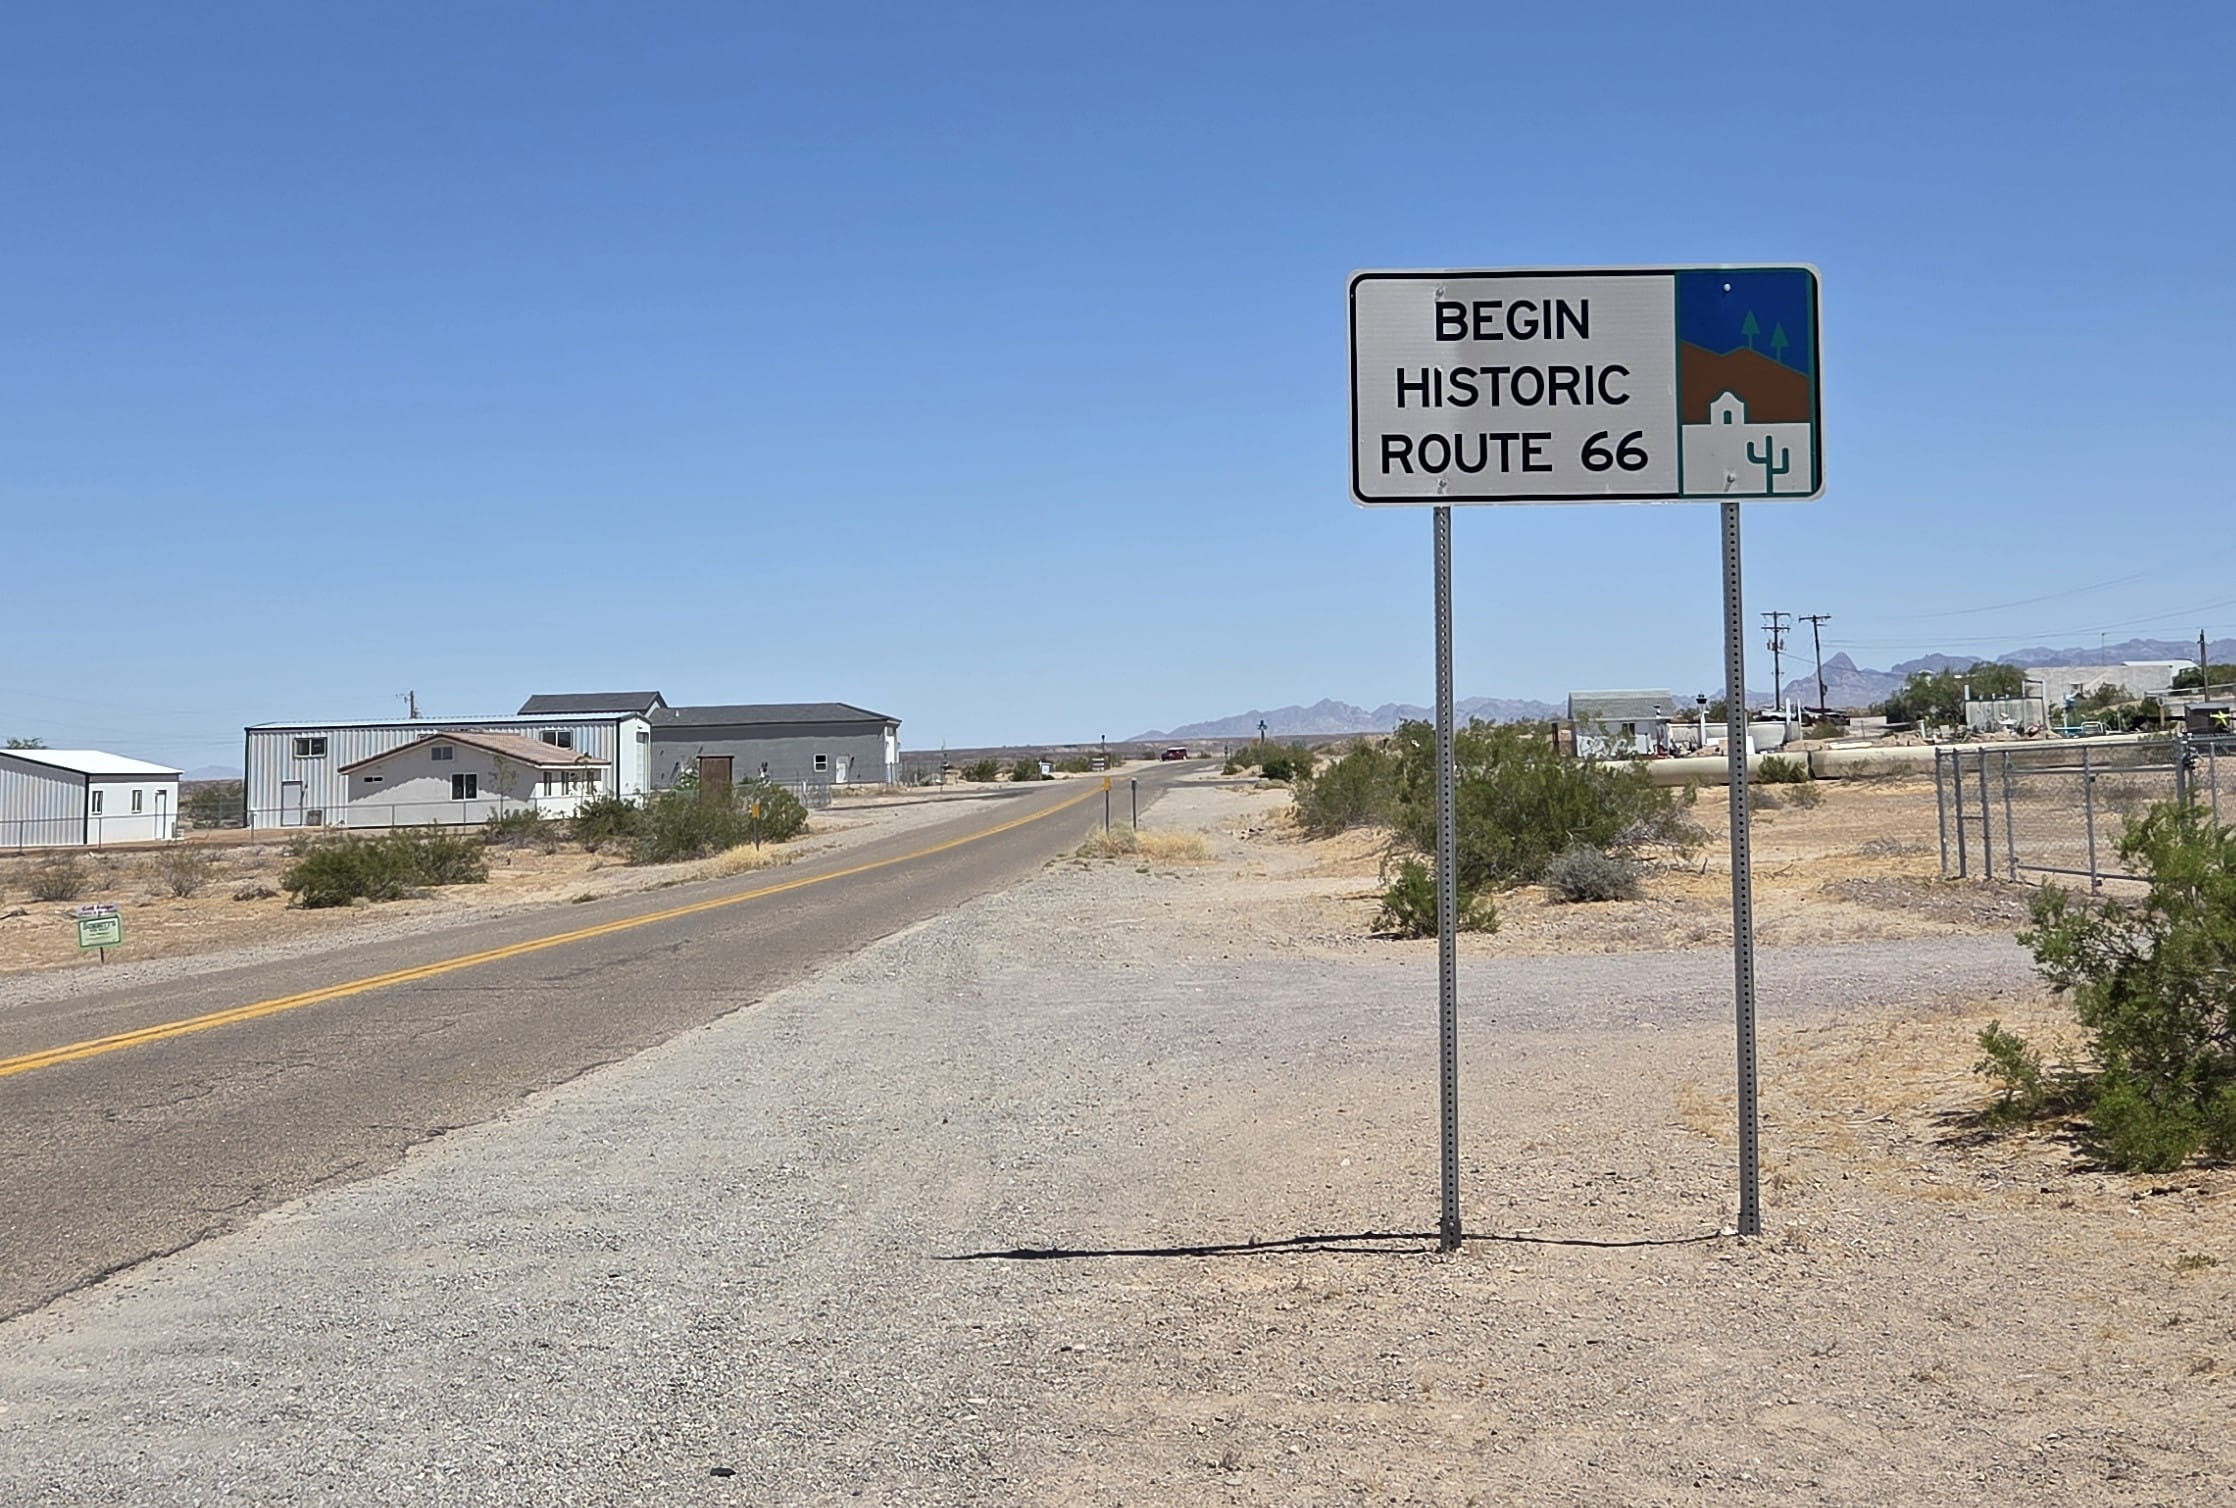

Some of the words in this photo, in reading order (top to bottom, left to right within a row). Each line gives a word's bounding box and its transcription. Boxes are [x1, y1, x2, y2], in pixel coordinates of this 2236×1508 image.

[1435, 298, 1590, 342] BEGIN
[1396, 364, 1631, 409] HISTORIC
[1381, 431, 1553, 475] ROUTE
[1580, 430, 1649, 472] 66
